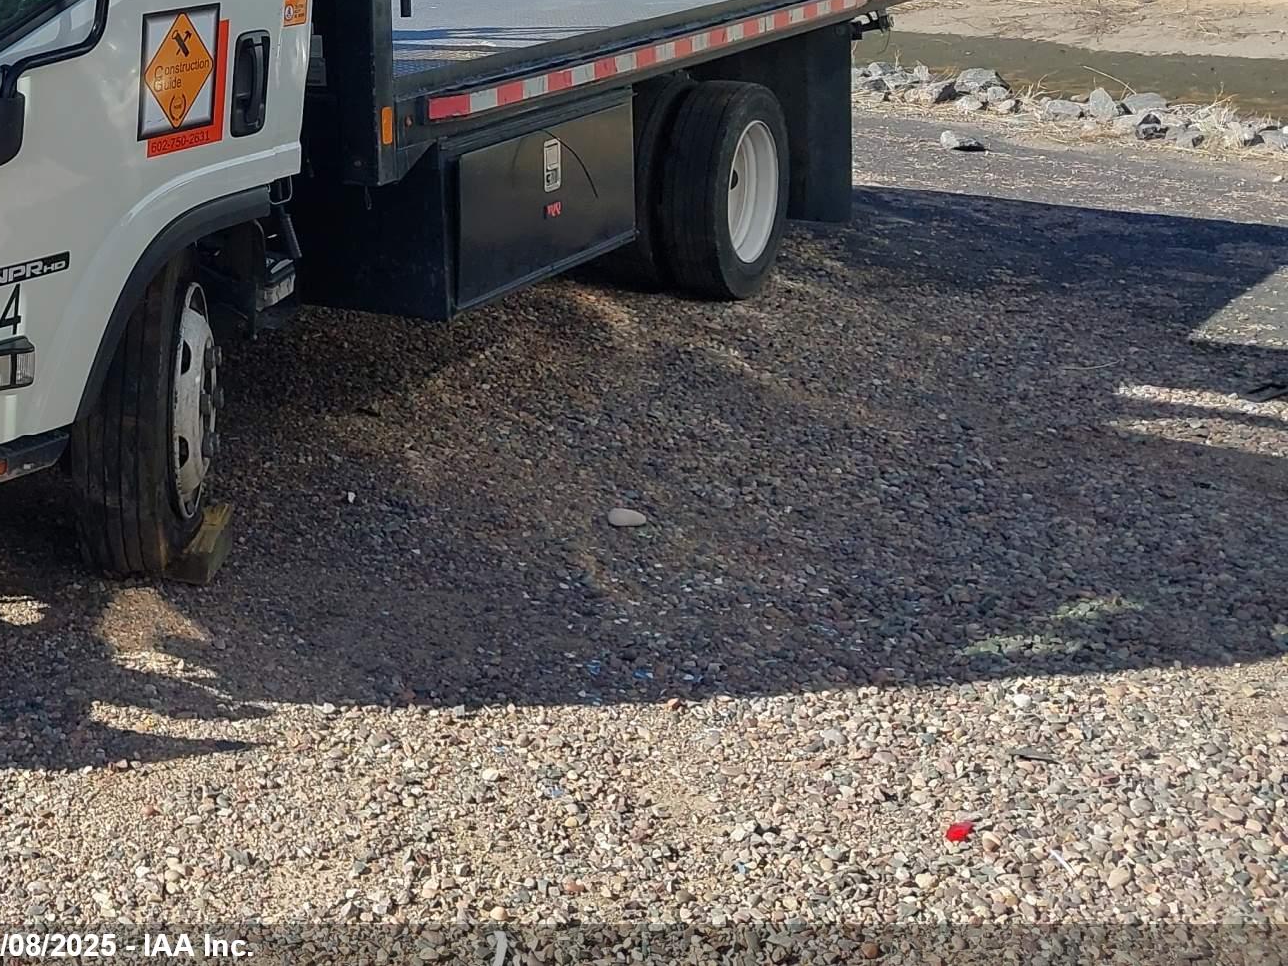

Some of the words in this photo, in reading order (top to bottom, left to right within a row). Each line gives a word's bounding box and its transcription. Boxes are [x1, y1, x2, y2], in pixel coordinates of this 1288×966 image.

[154, 58, 210, 80] Construction
[153, 77, 182, 93] Guide
[43, 260, 66, 274] HD
